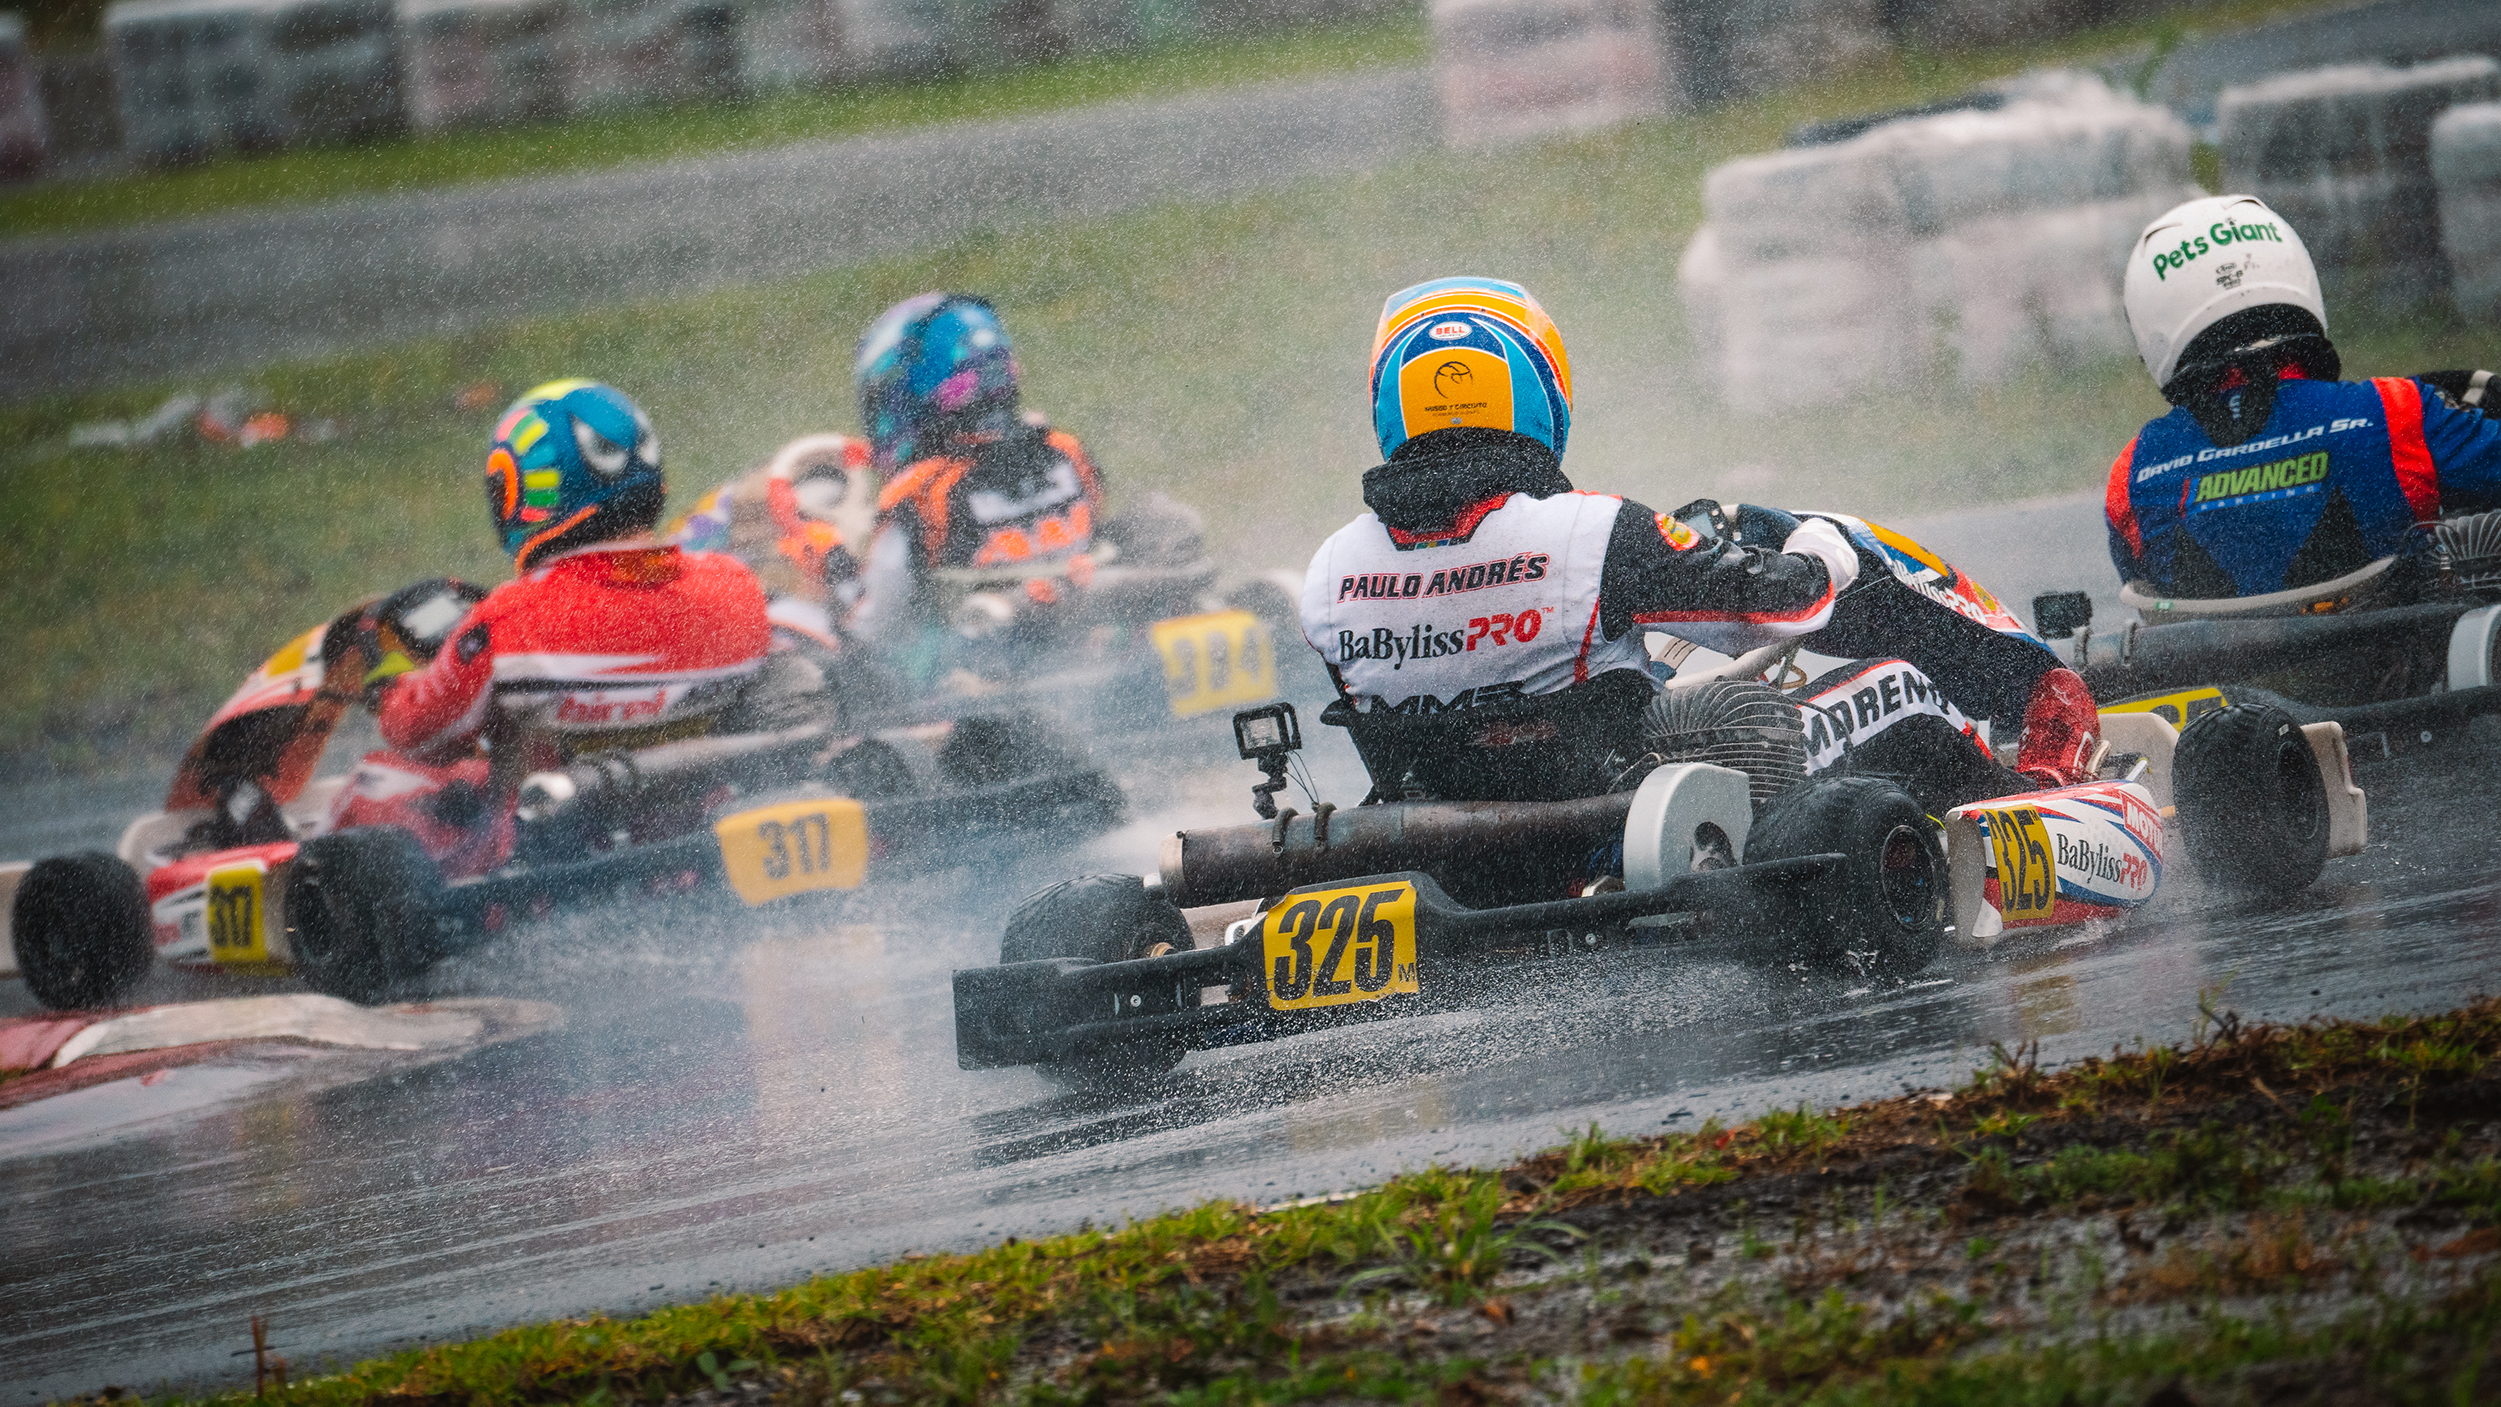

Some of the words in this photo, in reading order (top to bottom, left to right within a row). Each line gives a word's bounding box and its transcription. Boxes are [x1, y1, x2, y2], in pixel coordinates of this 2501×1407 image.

[2153, 236, 2209, 281] Pets
[2210, 222, 2282, 246] Giant
[1436, 326, 1465, 335] BELL
[2137, 455, 2193, 483] DAVID
[2197, 426, 2324, 462] GARDELLA
[2195, 452, 2328, 502] ADVANCED
[1337, 573, 1423, 603] PAULO
[1422, 552, 1550, 598] ANDRÉS
[757, 813, 830, 881] 317
[1985, 809, 2050, 914] 325
[2056, 832, 2147, 891] BaBylissPRO
[1274, 888, 1406, 1001] 325
[1397, 962, 1416, 983] M
